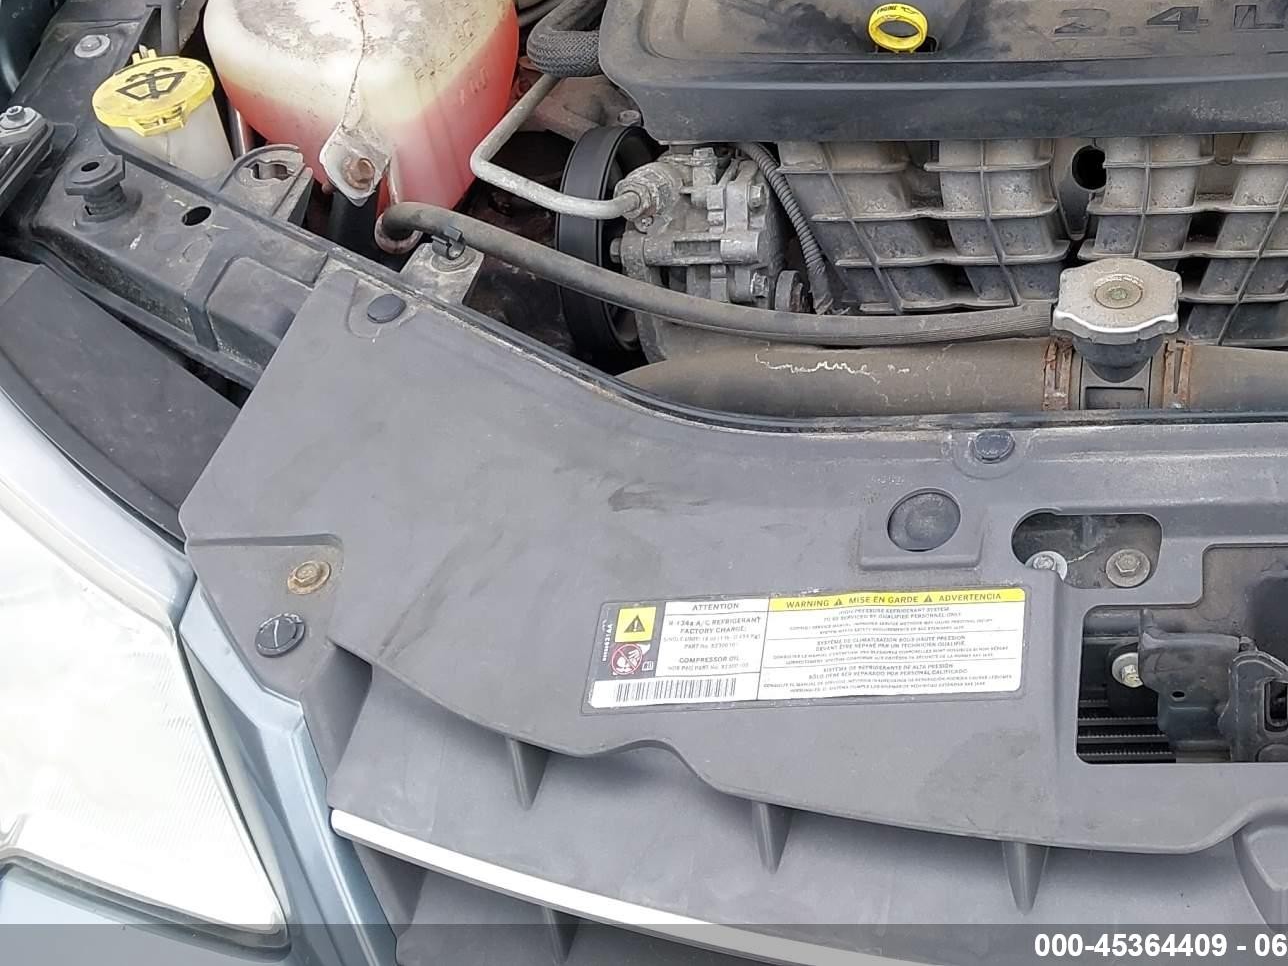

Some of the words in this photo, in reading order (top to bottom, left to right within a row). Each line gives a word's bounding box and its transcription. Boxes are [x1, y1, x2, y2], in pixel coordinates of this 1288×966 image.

[1052, 3, 1209, 37] 2.4
[1232, 4, 1285, 32] L
[786, 600, 830, 609] WARNING
[848, 596, 871, 604] MISE
[887, 595, 919, 603] GARDE
[938, 593, 1002, 602] ADVERTENCIA
[691, 602, 739, 611] ATTENTION
[680, 627, 714, 635] FACTORY
[679, 655, 728, 663] COMPRESSOR
